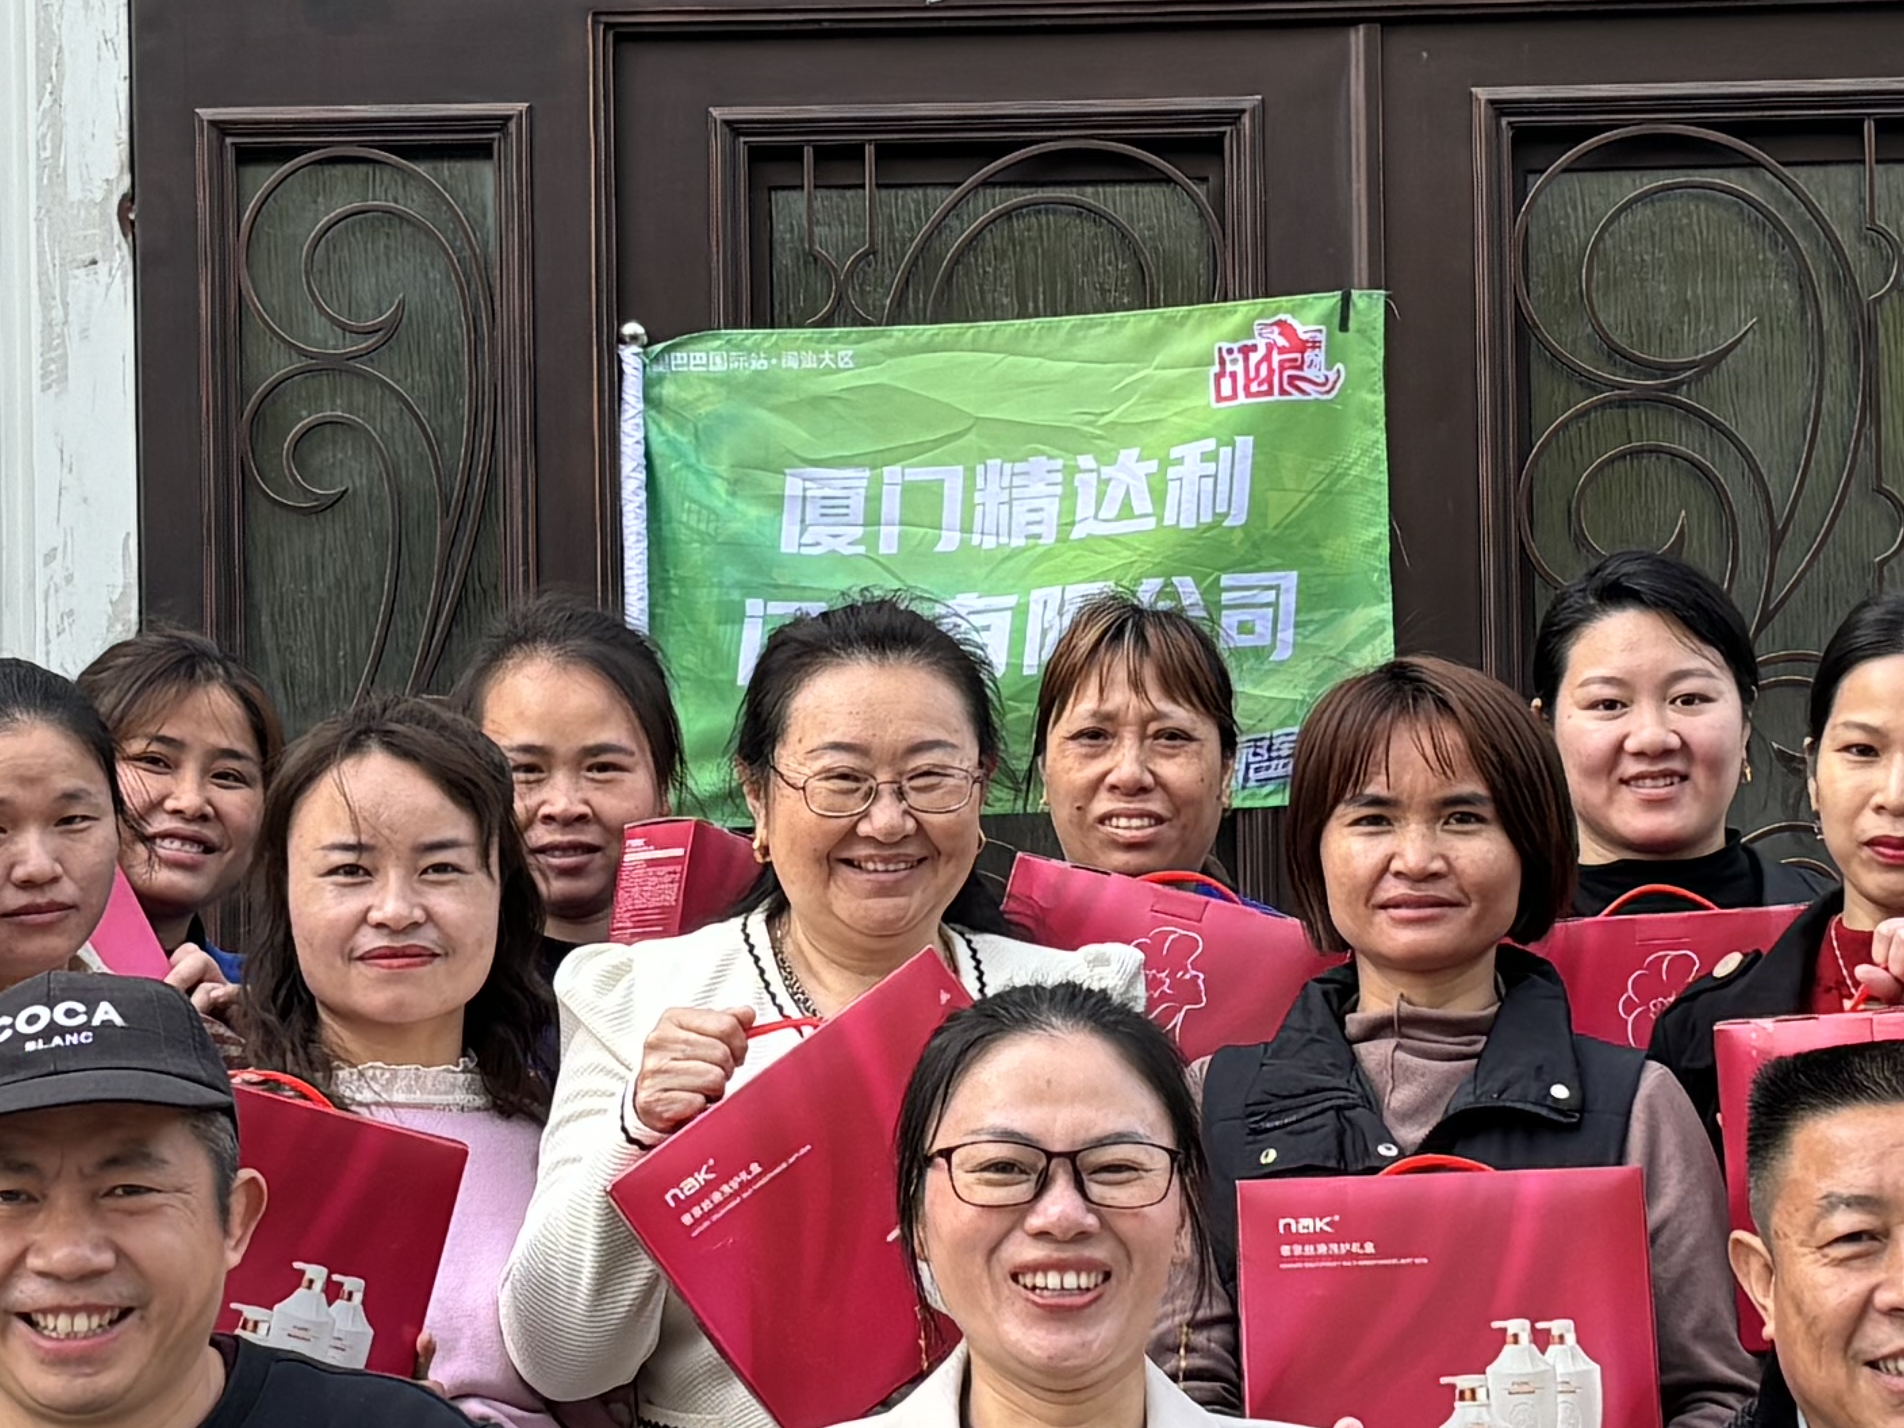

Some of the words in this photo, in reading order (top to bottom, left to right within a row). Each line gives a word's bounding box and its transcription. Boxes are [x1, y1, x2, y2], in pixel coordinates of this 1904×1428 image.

[780, 435, 1254, 556] 厦门精达利
[24, 1031, 94, 1052] BLANC
